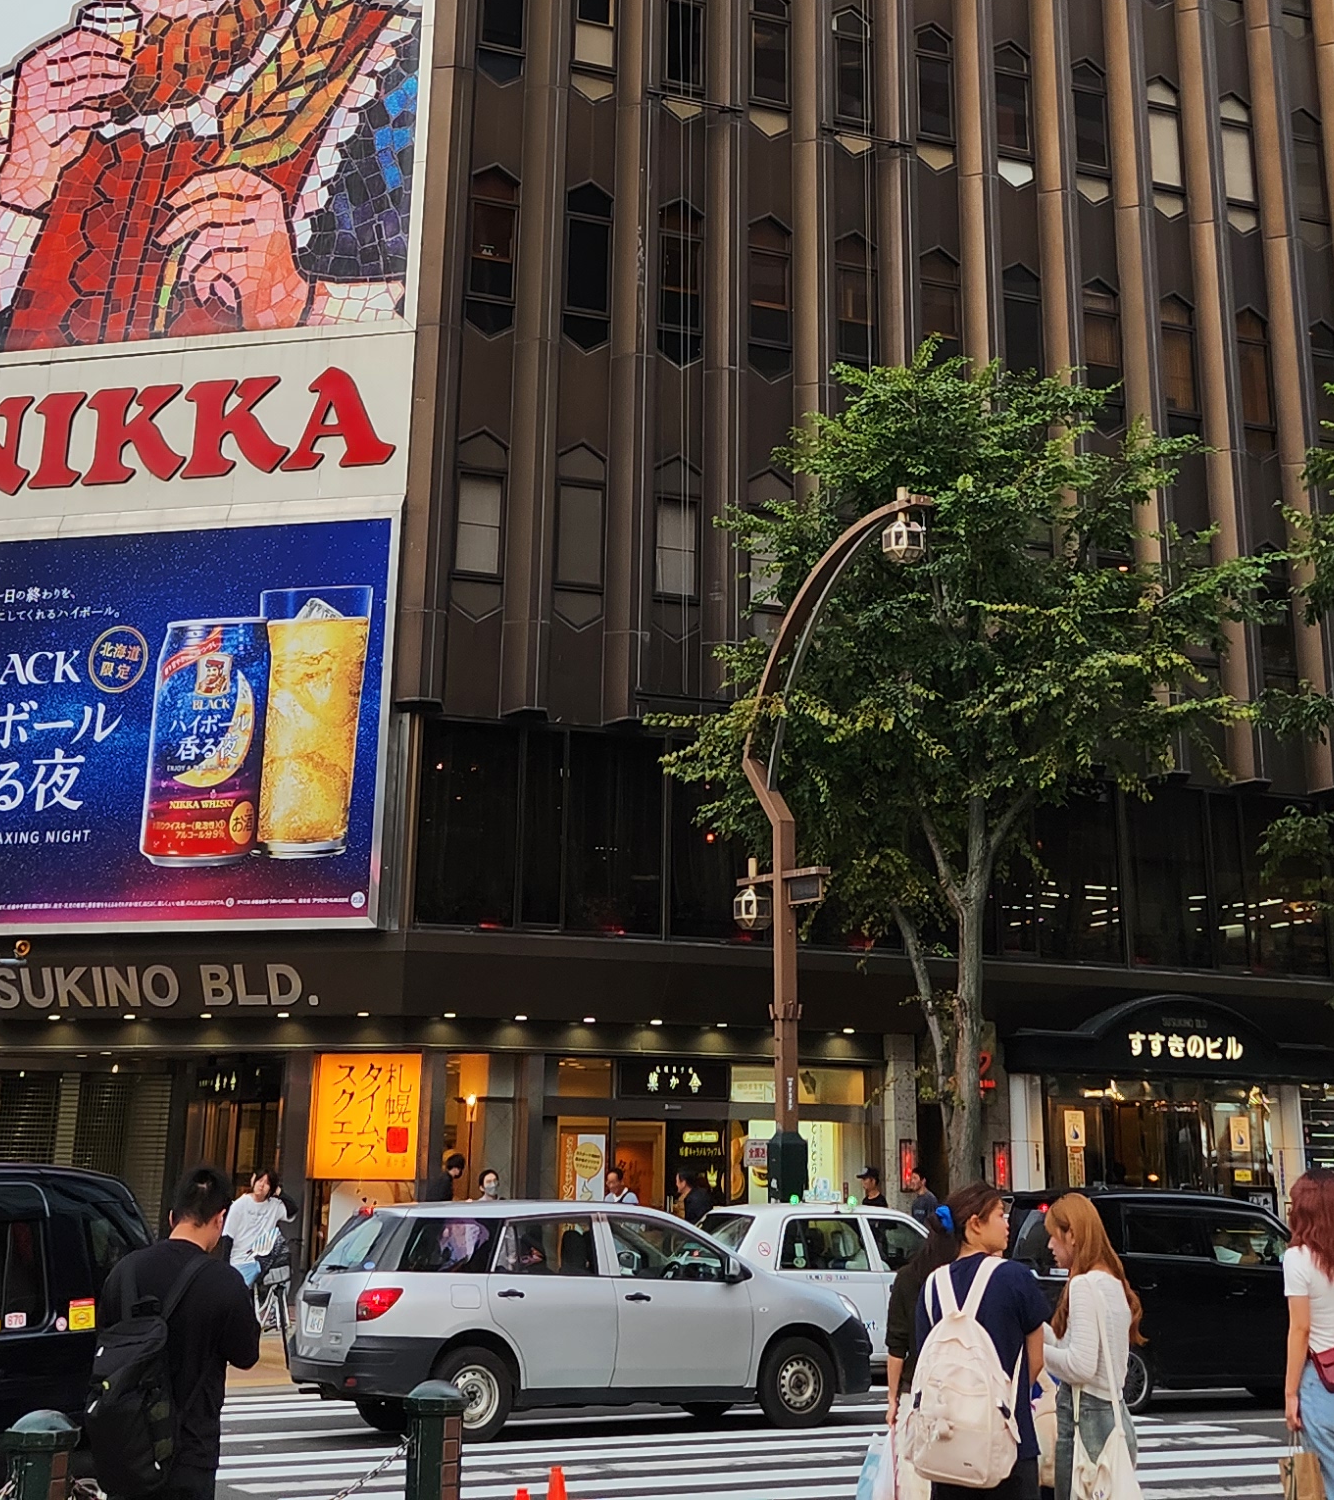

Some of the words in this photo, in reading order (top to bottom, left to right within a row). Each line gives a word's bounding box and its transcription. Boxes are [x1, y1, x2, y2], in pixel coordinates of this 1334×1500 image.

[99, 642, 142, 662] 北海道
[99, 662, 130, 680] 限定
[192, 699, 231, 711] BLACK
[170, 715, 250, 736] ハイボール
[175, 734, 241, 761] 香る夜
[169, 800, 200, 810] NIKKA
[201, 799, 234, 809] WHISKY
[231, 812, 255, 833] お酒
[45, 828, 92, 844] NIGHT
[199, 963, 320, 1007] BLD.
[1161, 1016, 1194, 1029] SUSUKINO
[1128, 1030, 1244, 1061] すすきのビル
[384, 1062, 412, 1126] 札幌
[329, 1063, 357, 1168] スクエア
[354, 1062, 385, 1165] タイムズ
[6, 1314, 24, 1327] 670
